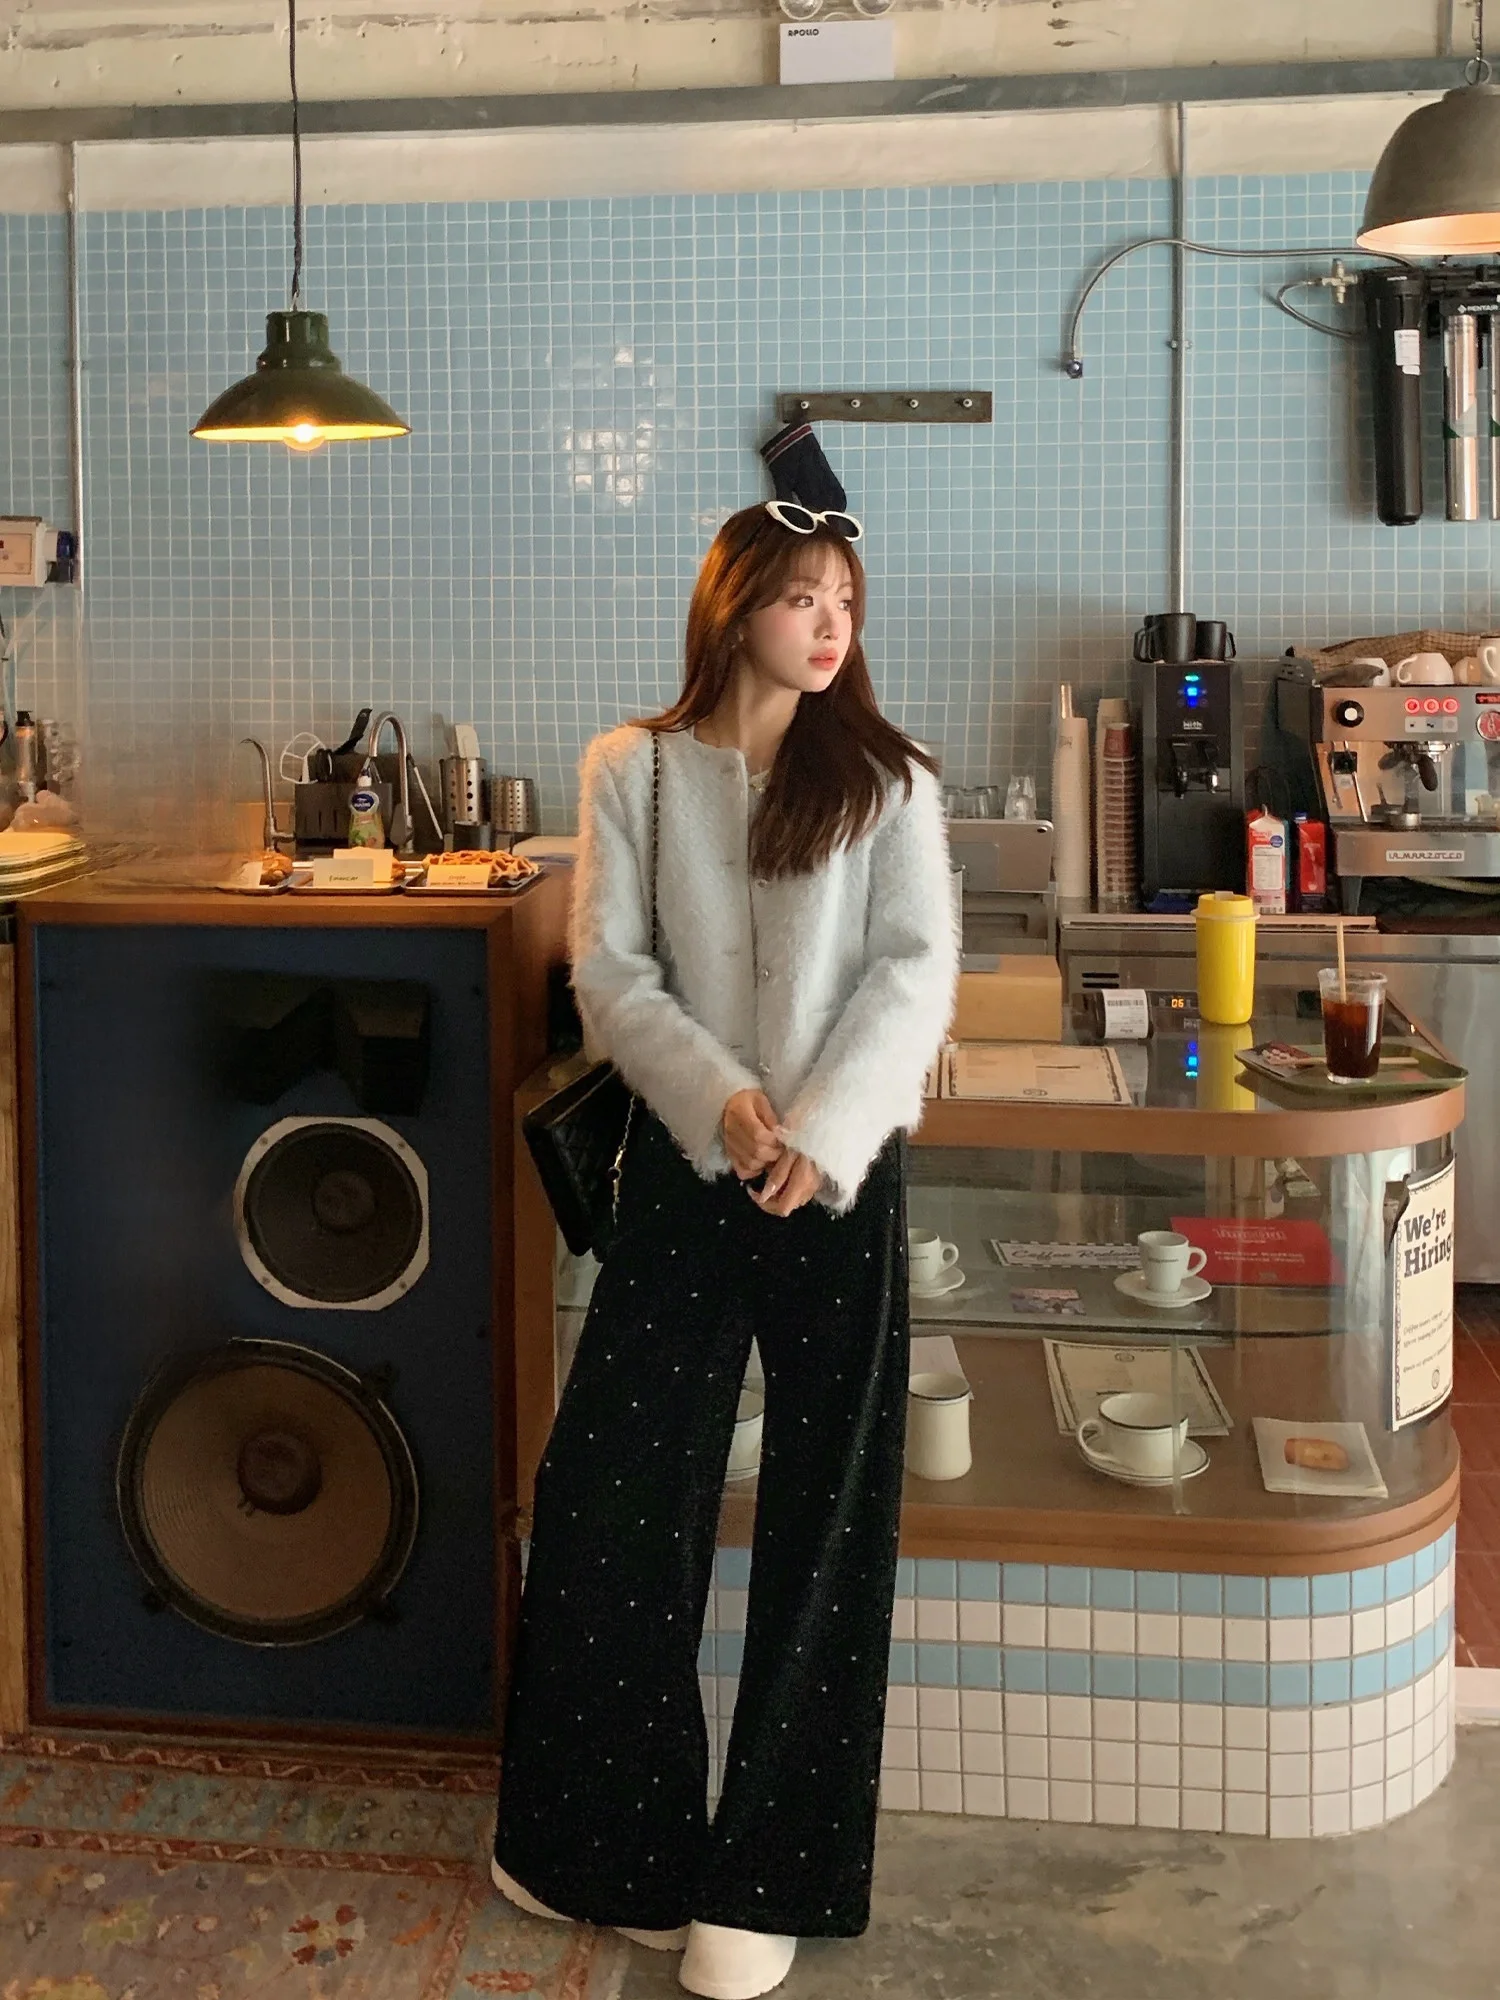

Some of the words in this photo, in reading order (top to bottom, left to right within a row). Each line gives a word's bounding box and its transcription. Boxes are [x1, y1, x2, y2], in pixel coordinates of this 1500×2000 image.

[1404, 1208, 1446, 1243] We're
[1011, 1250, 1071, 1261] Coffee
[1403, 1232, 1452, 1279] Hiring
